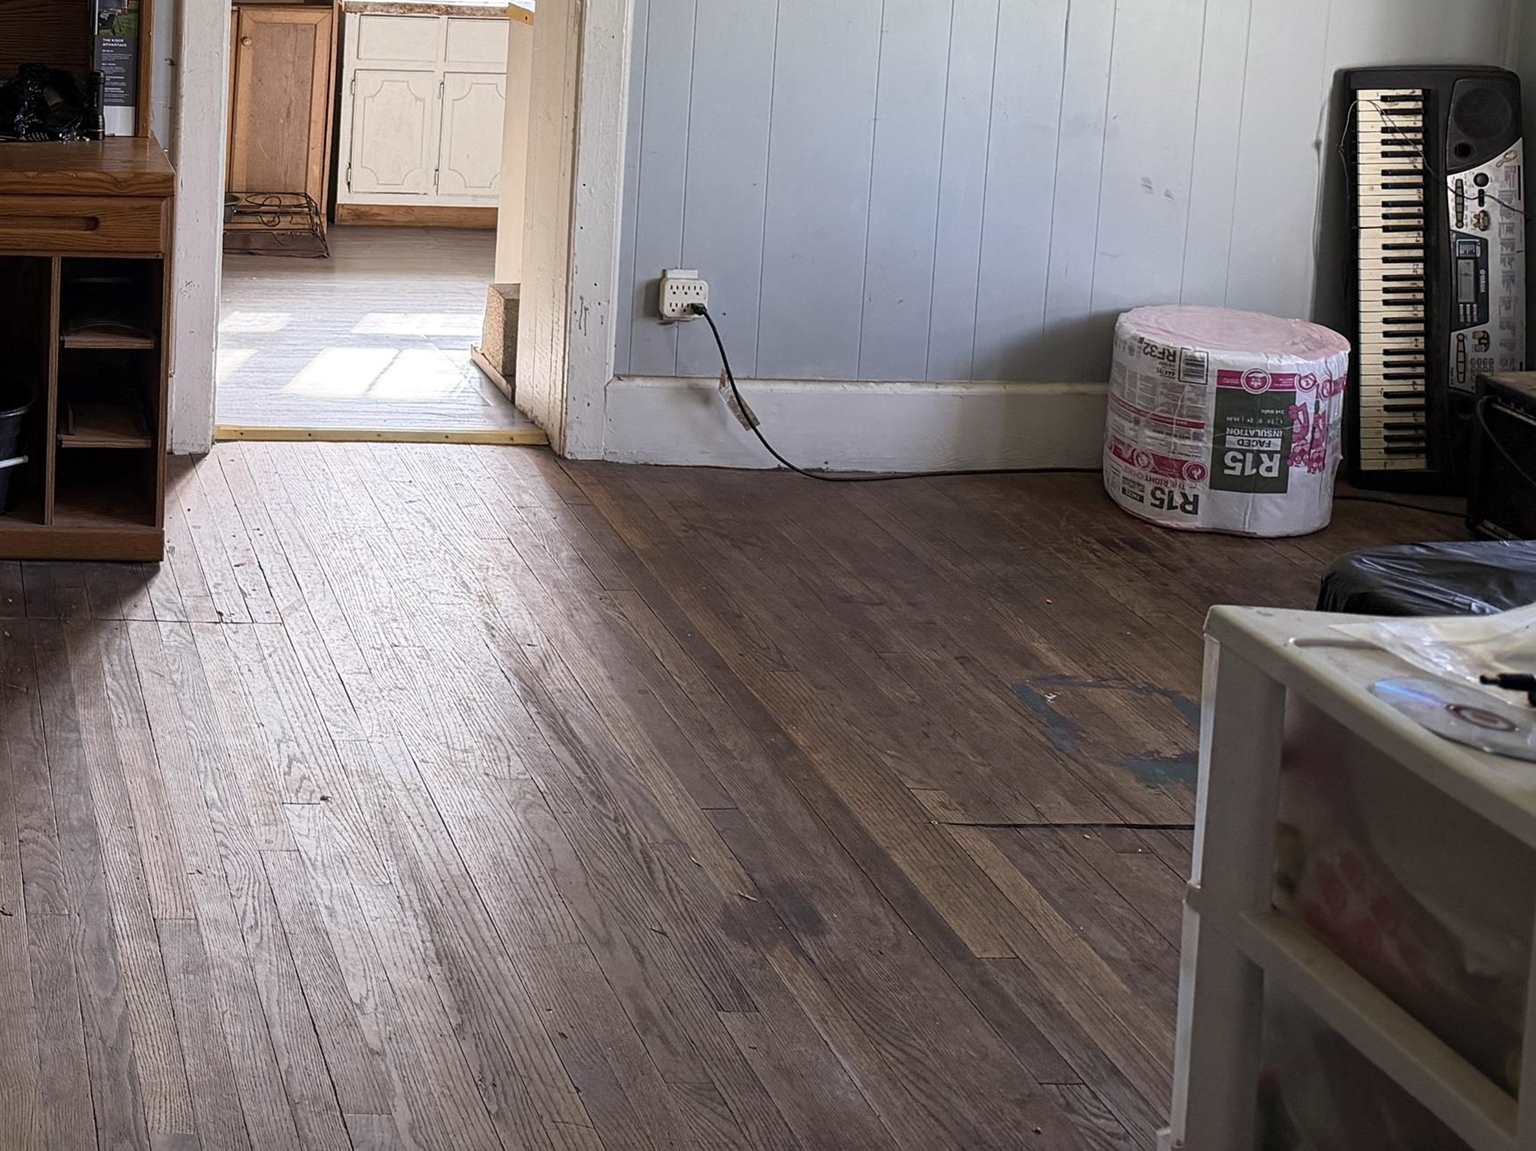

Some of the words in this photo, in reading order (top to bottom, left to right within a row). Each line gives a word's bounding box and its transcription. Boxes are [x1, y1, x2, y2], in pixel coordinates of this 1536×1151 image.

[1226, 427, 1283, 438] INSULATION
[1237, 438, 1272, 448] FACED
[1223, 451, 1281, 478] R15
[1150, 486, 1200, 515] R15
